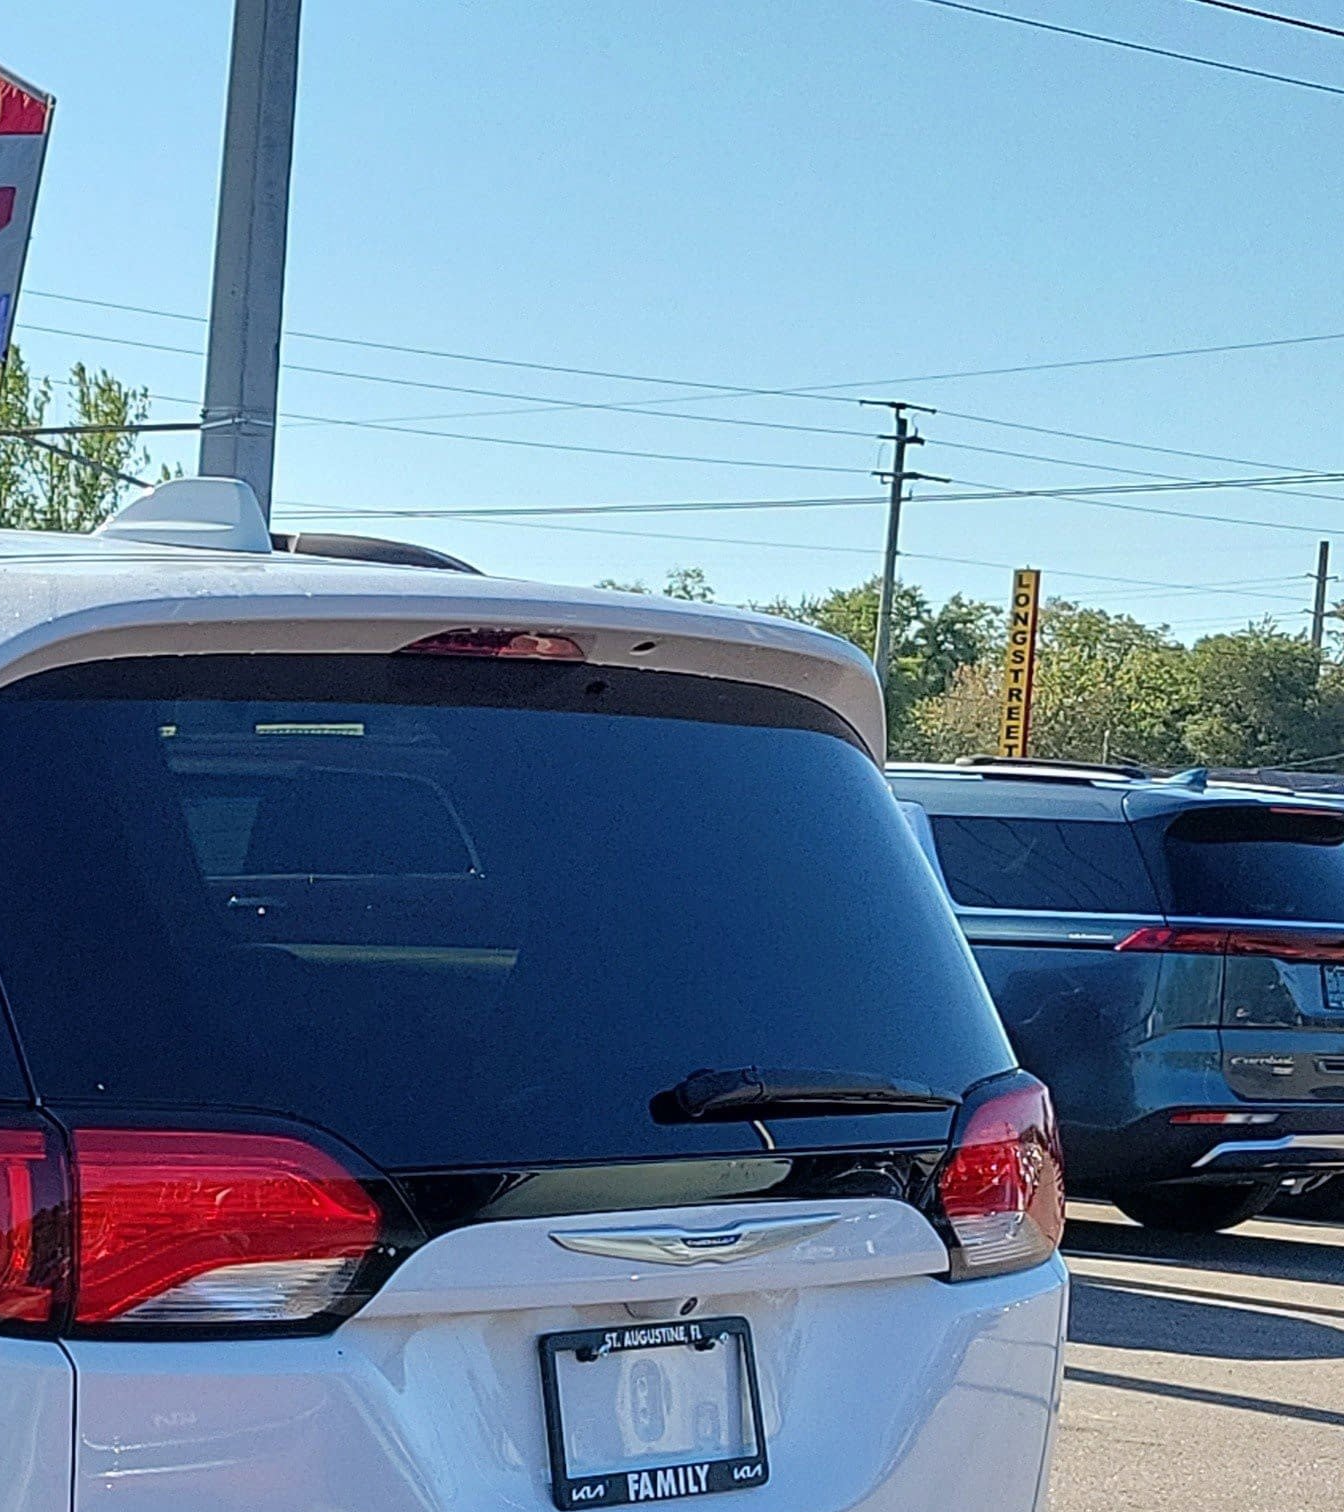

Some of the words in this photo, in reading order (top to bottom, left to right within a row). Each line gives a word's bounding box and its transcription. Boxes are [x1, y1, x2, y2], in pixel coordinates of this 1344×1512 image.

[1003, 574, 1031, 757] LONGSTREET
[604, 1332, 621, 1348] ST.
[623, 1326, 689, 1347] AUGUSTINE,
[690, 1324, 702, 1341] FL
[627, 1464, 710, 1501] FAMILY
